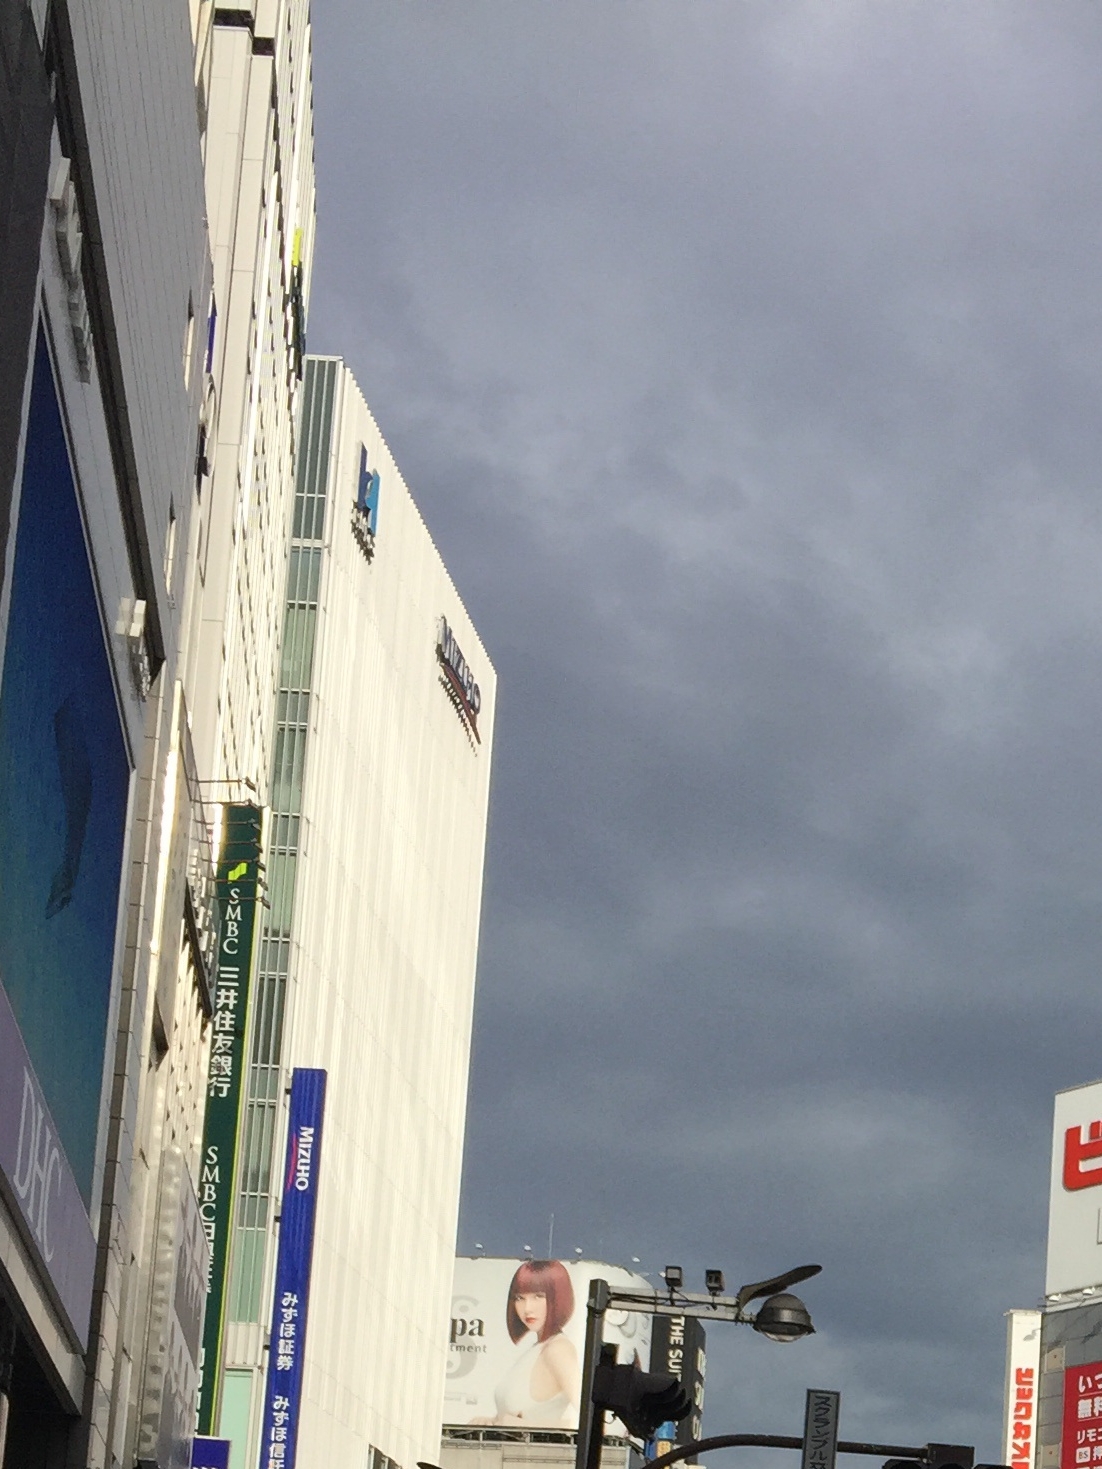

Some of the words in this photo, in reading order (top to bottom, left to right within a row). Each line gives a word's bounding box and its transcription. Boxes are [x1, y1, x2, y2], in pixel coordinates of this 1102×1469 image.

[222, 887, 242, 955] SMBC
[209, 966, 239, 1098] 三井住友銀行
[13, 1066, 62, 1263] DHC
[199, 1146, 221, 1222] SMBC
[295, 1126, 314, 1191] MIZUHO
[276, 1292, 299, 1371] みずほ証券
[671, 1315, 685, 1347] THE
